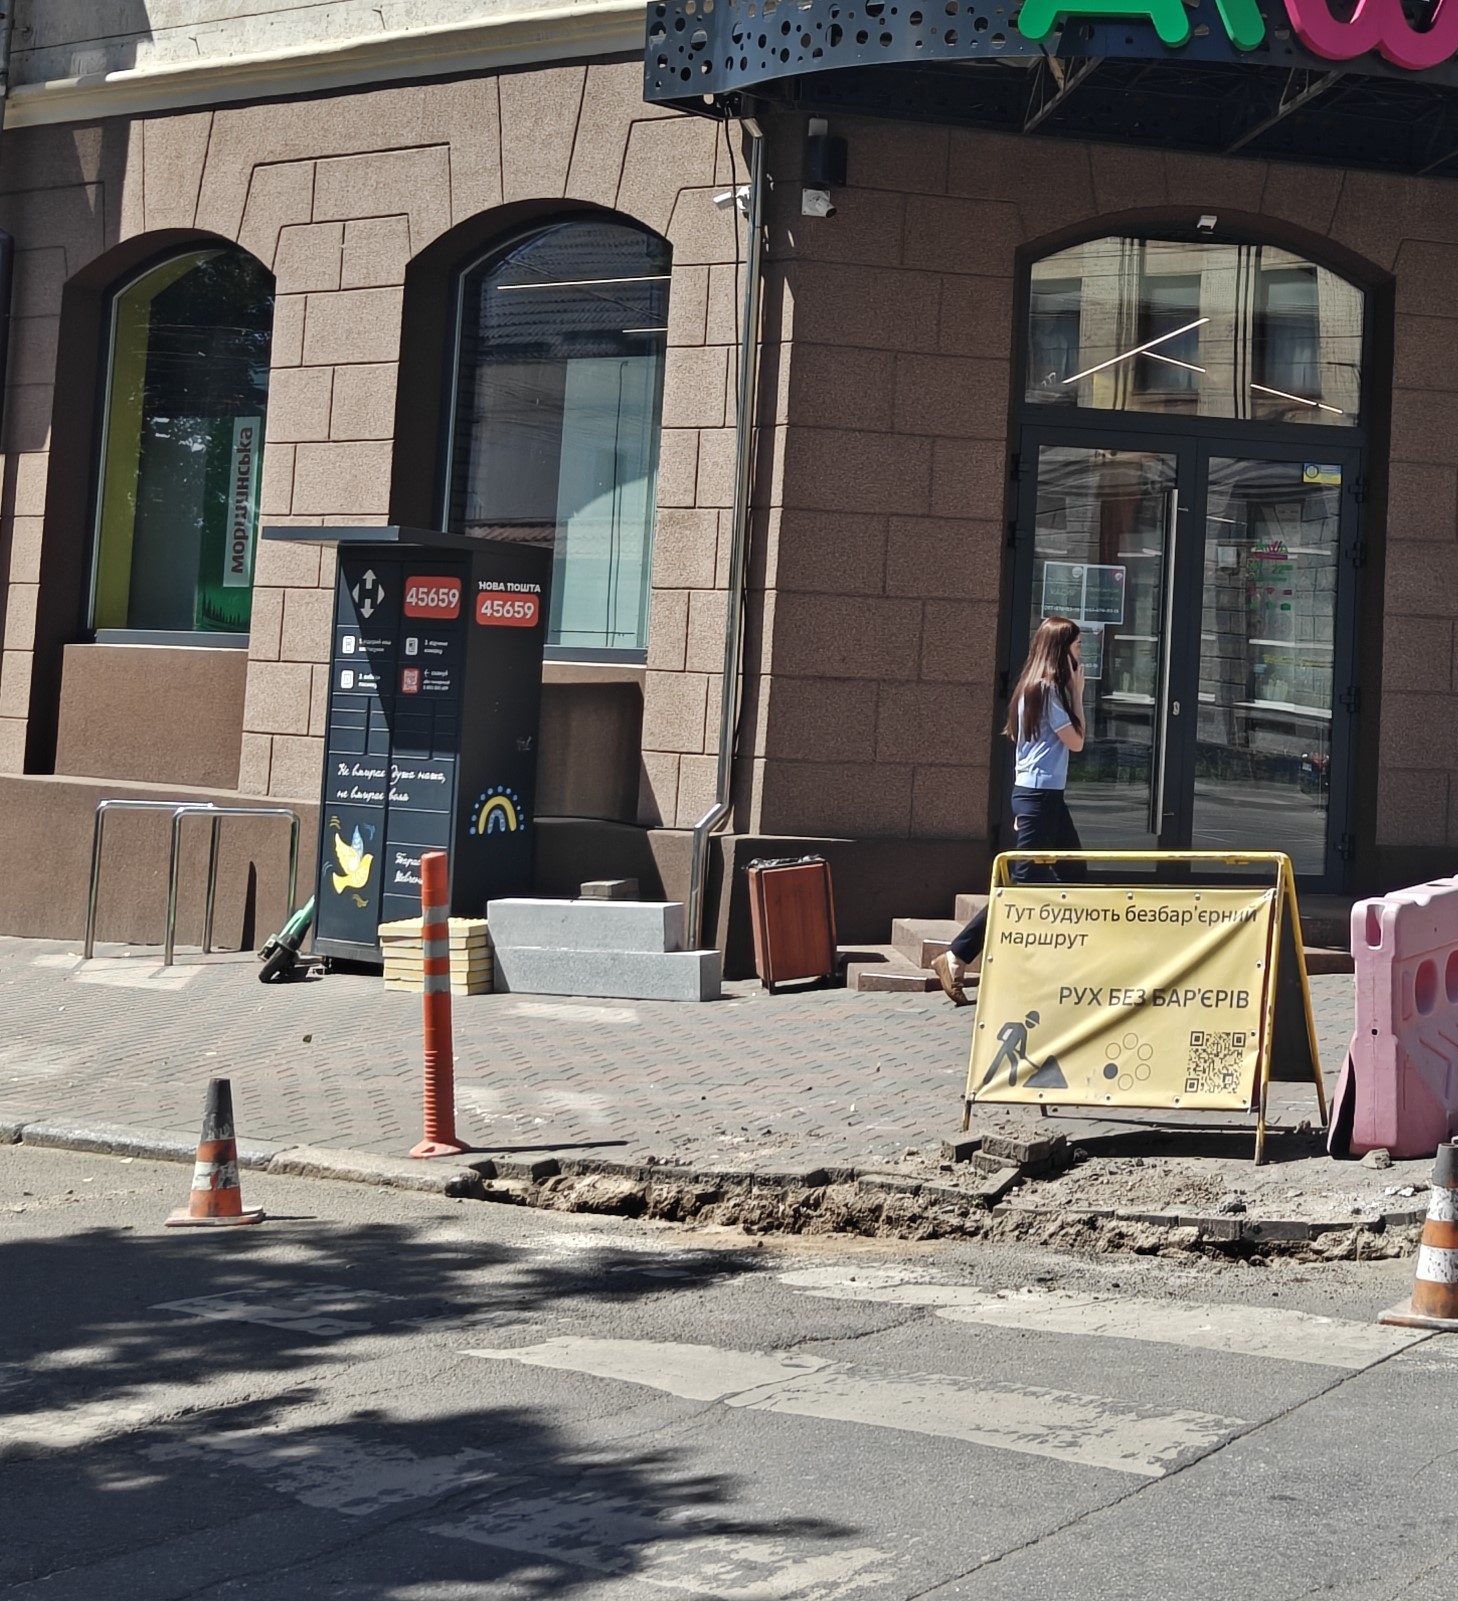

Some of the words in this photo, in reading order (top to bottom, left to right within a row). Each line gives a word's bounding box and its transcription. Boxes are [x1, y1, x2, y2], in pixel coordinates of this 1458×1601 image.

[478, 581, 505, 591] НОВА
[506, 582, 541, 592] ПОШТА
[406, 587, 459, 608] 45659
[481, 600, 535, 619] 45659
[1004, 904, 1036, 924] Тут
[1039, 903, 1121, 924] будують
[1124, 904, 1258, 926] безбар'єрний
[1000, 931, 1089, 949] маршрут
[1059, 986, 1103, 1006] РУХ
[1108, 988, 1147, 1007] БЕЗ
[1151, 988, 1251, 1009] БАР'ЄРІВ
